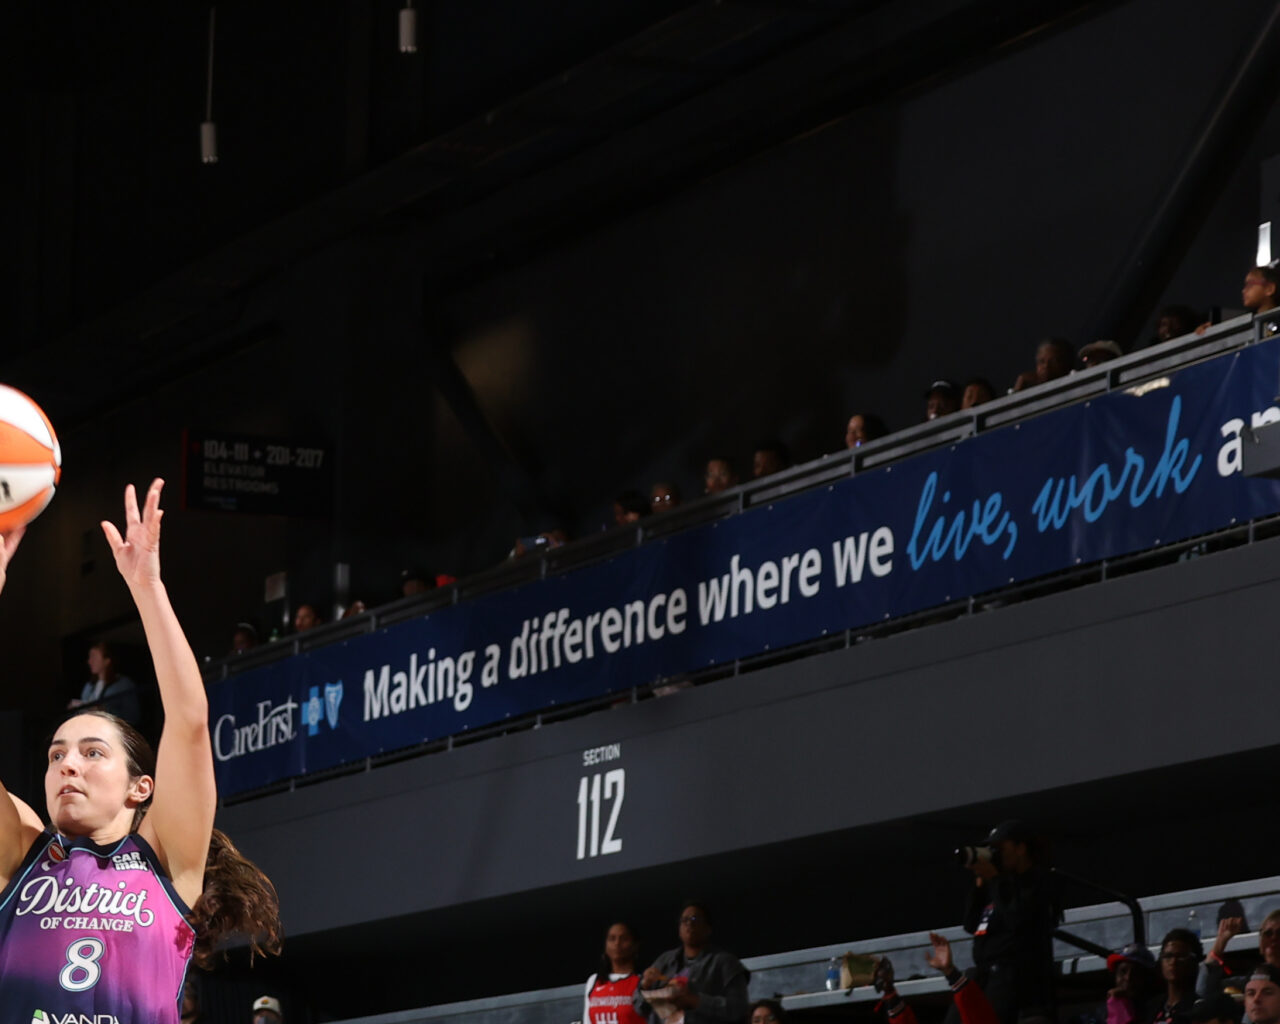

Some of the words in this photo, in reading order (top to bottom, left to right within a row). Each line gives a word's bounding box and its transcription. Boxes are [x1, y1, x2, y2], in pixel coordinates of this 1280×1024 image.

[363, 648, 476, 721] Making
[480, 644, 501, 688] a
[508, 588, 687, 680] difference
[698, 548, 821, 625] where
[833, 526, 895, 587] we
[906, 471, 1018, 571] live,
[1031, 395, 1202, 533] work
[214, 695, 299, 761] CareFirst
[583, 743, 620, 766] SECTION
[577, 768, 625, 860] 112
[112, 852, 141, 863] CAR
[16, 875, 155, 927] District
[40, 917, 62, 930] OF
[63, 917, 134, 932] CHANGE
[59, 937, 105, 992] 8
